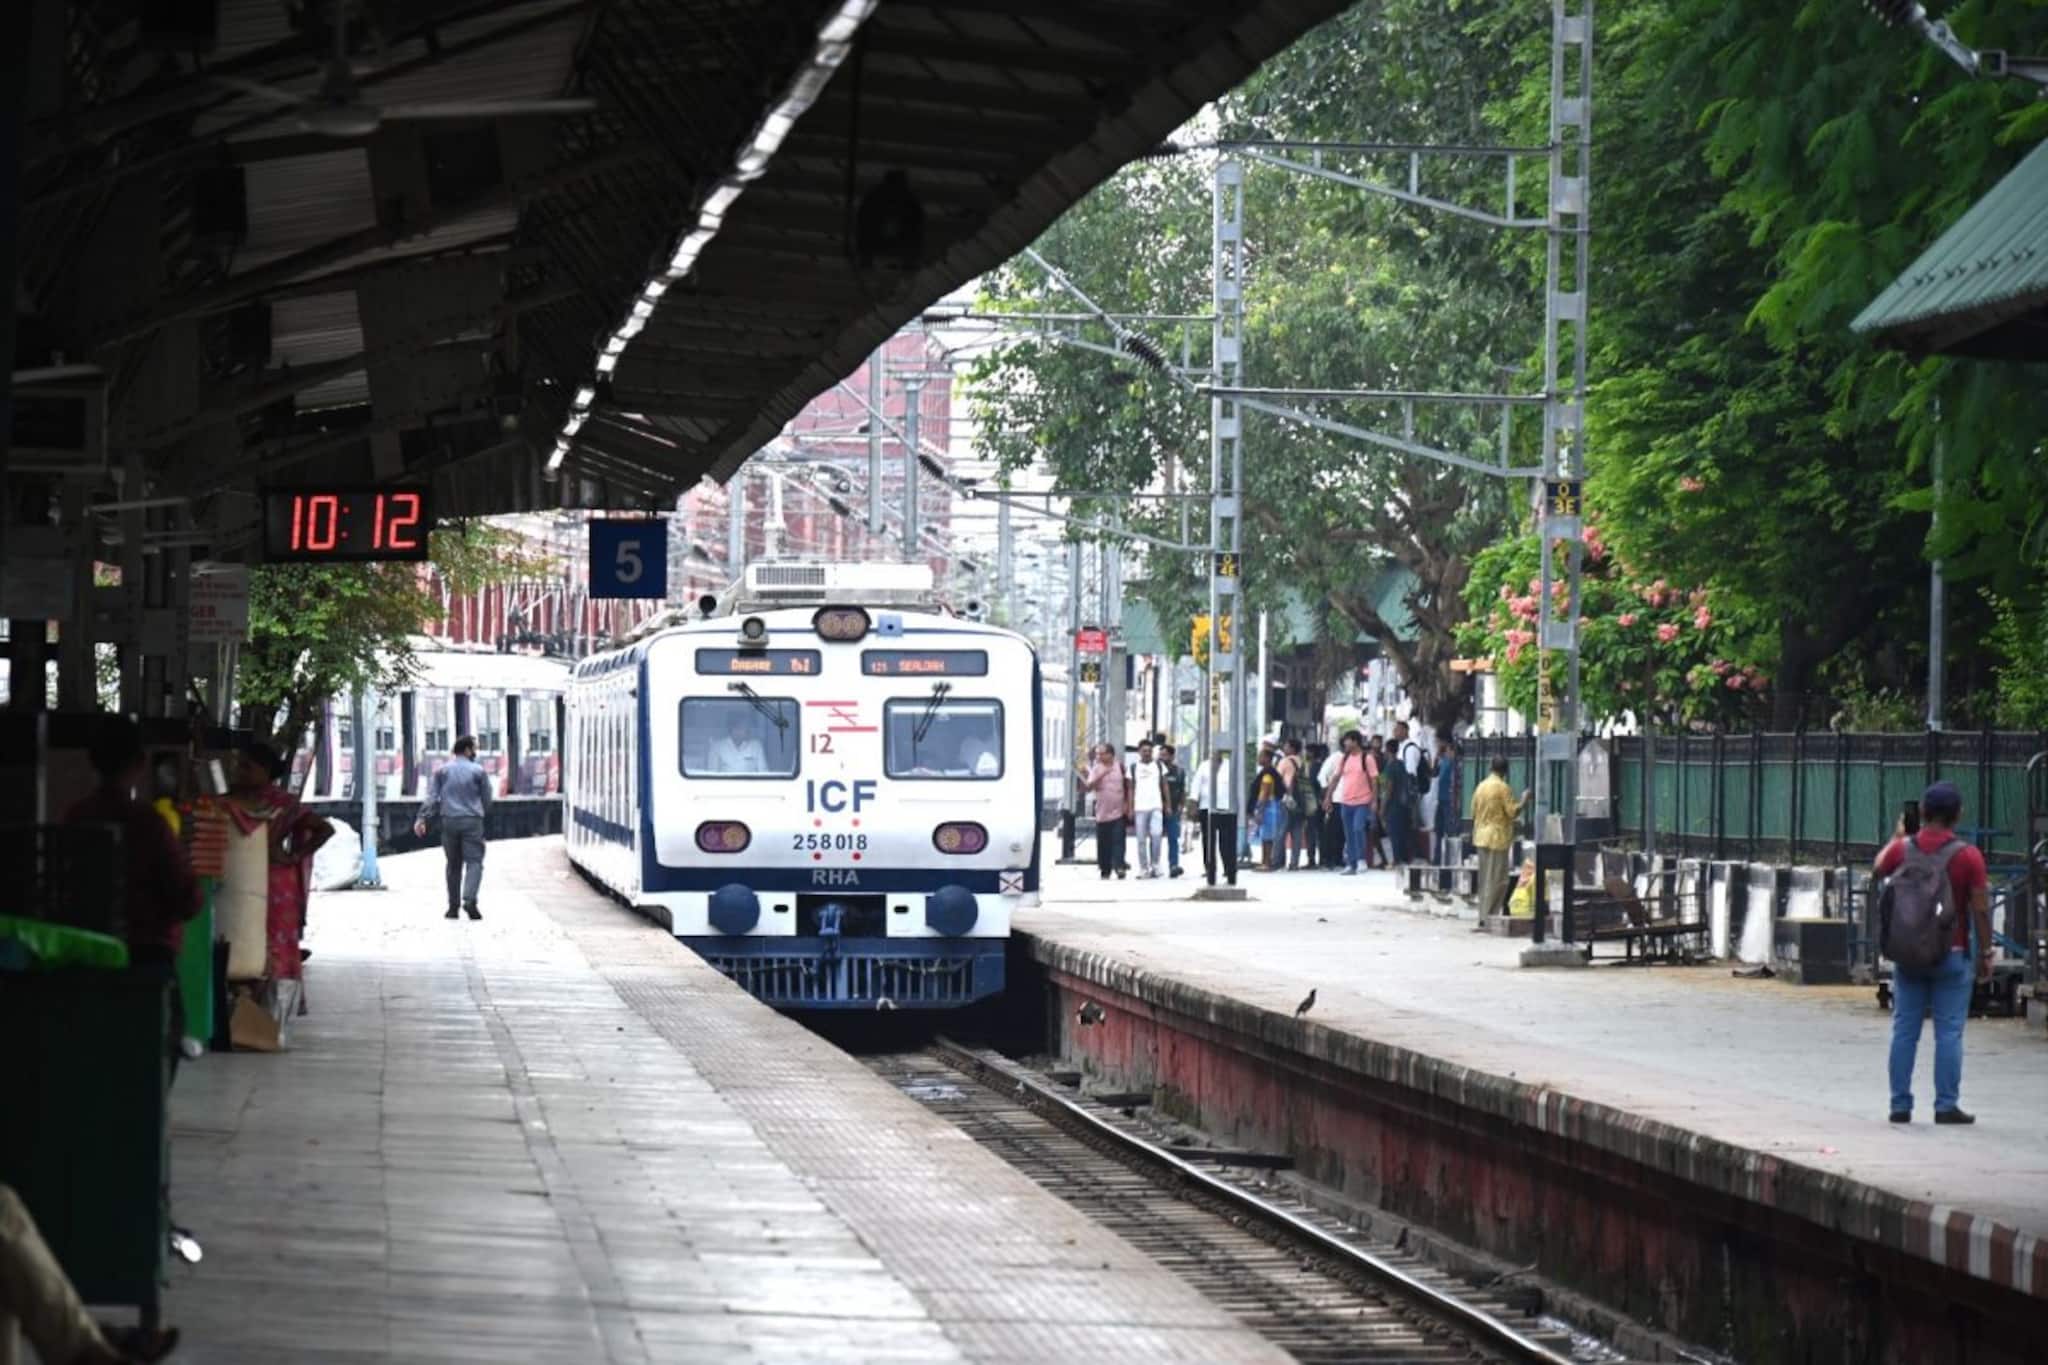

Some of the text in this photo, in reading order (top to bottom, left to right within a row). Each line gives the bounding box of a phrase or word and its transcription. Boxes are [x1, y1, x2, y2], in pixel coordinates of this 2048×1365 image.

[615, 540, 643, 584] 5
[810, 733, 835, 754] 12
[806, 779, 878, 814] ICF
[811, 869, 860, 886] RHA
